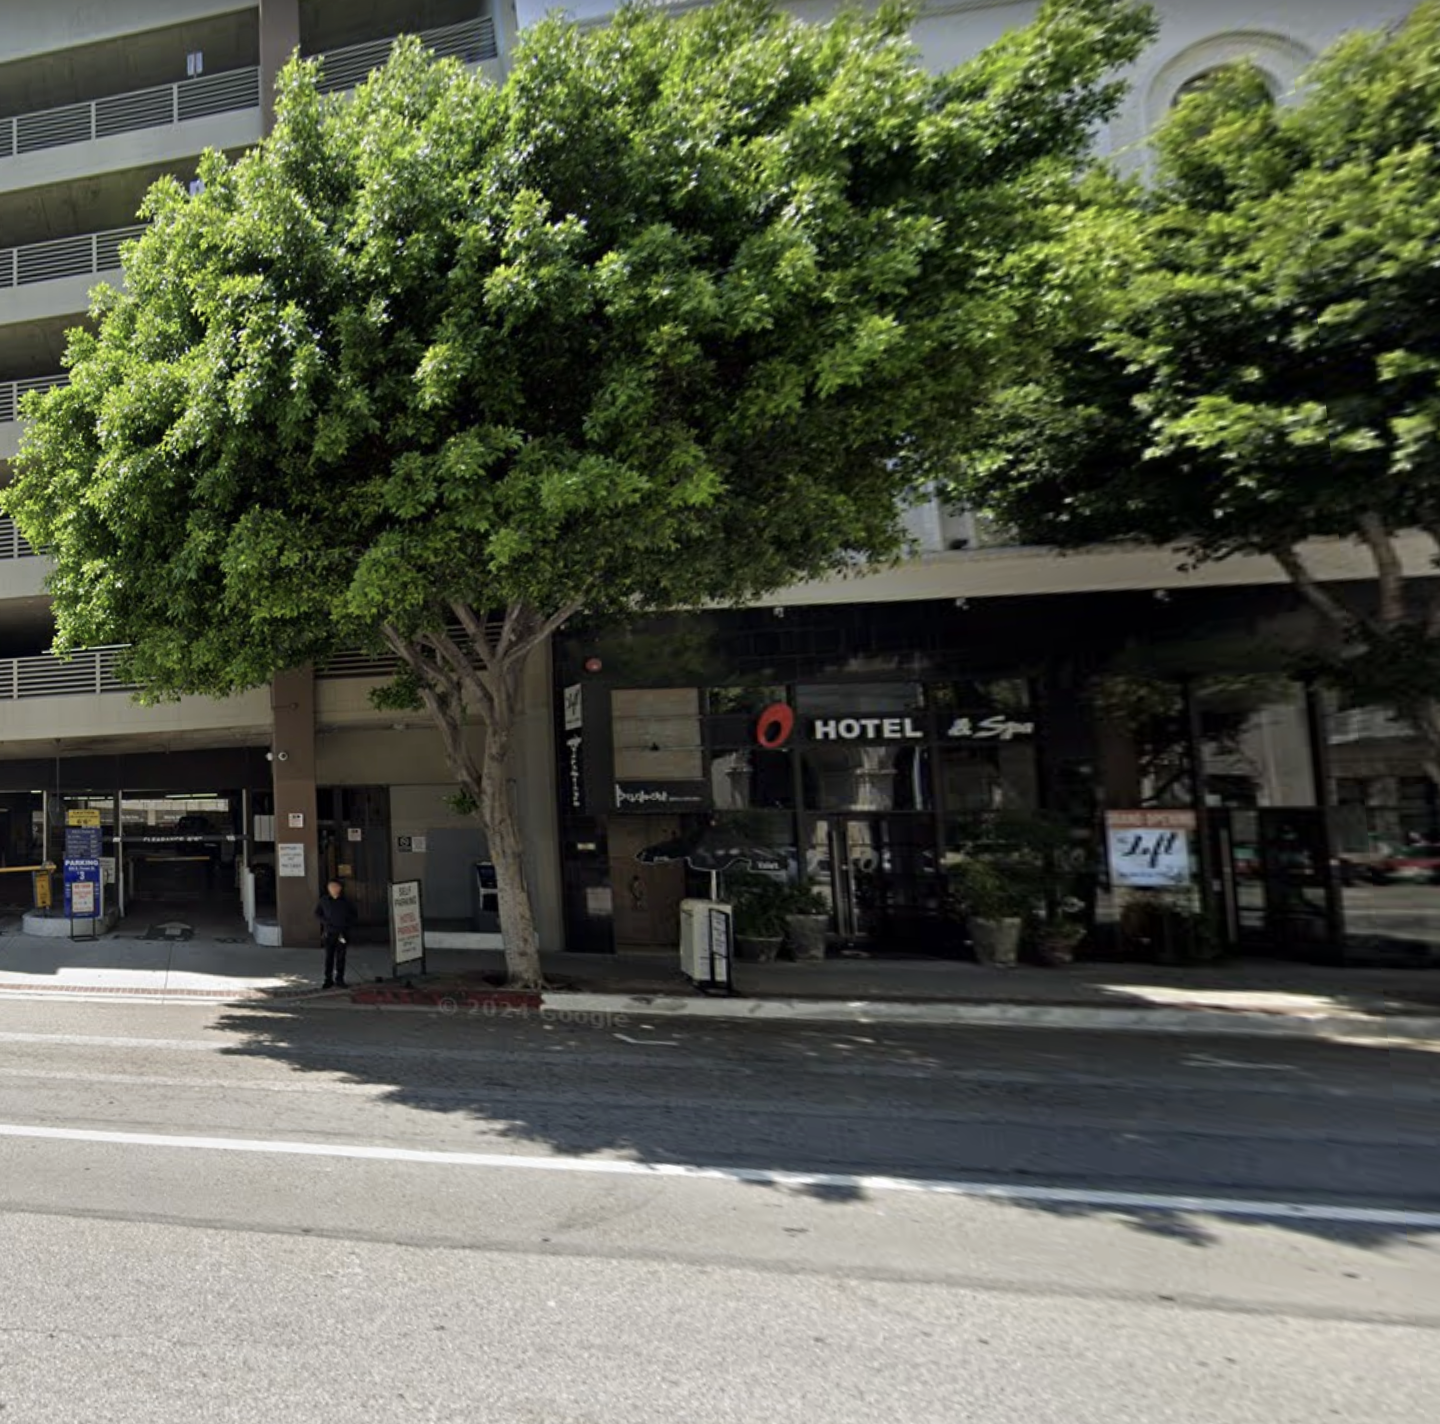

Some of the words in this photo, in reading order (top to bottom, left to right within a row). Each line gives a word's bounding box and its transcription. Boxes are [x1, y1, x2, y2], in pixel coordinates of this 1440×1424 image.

[814, 717, 924, 740] HOTEL
[947, 717, 973, 737] &
[972, 715, 1035, 741] Spa
[1120, 831, 1177, 869] Loft
